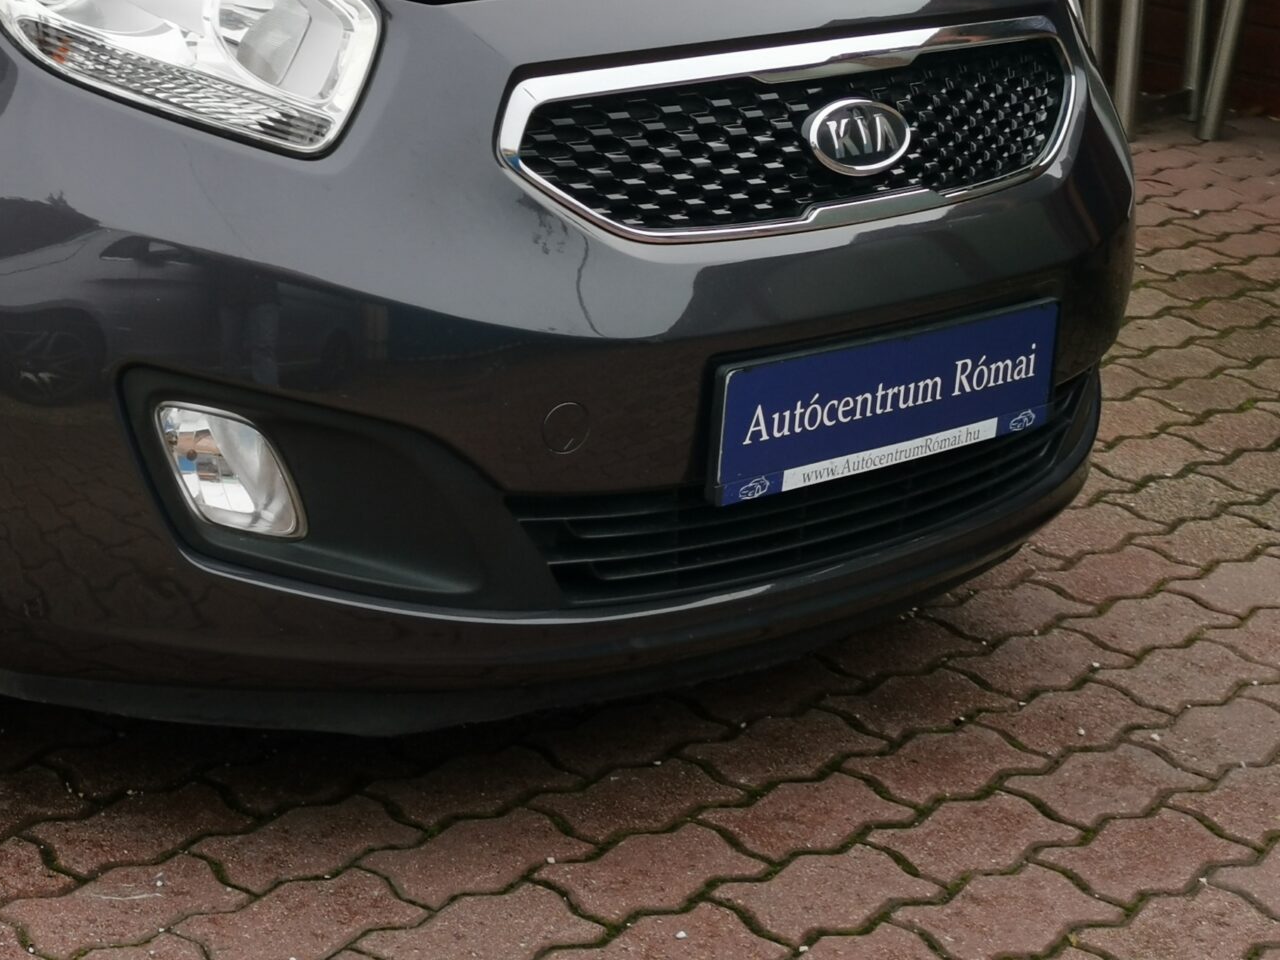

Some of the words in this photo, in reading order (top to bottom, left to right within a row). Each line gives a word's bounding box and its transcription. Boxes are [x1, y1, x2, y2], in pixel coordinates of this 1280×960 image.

[826, 113, 900, 159] KIA
[743, 375, 943, 445] Autócentrum
[952, 342, 1038, 397] Római
[801, 427, 981, 484] www.AutócentrumRómai.hu
